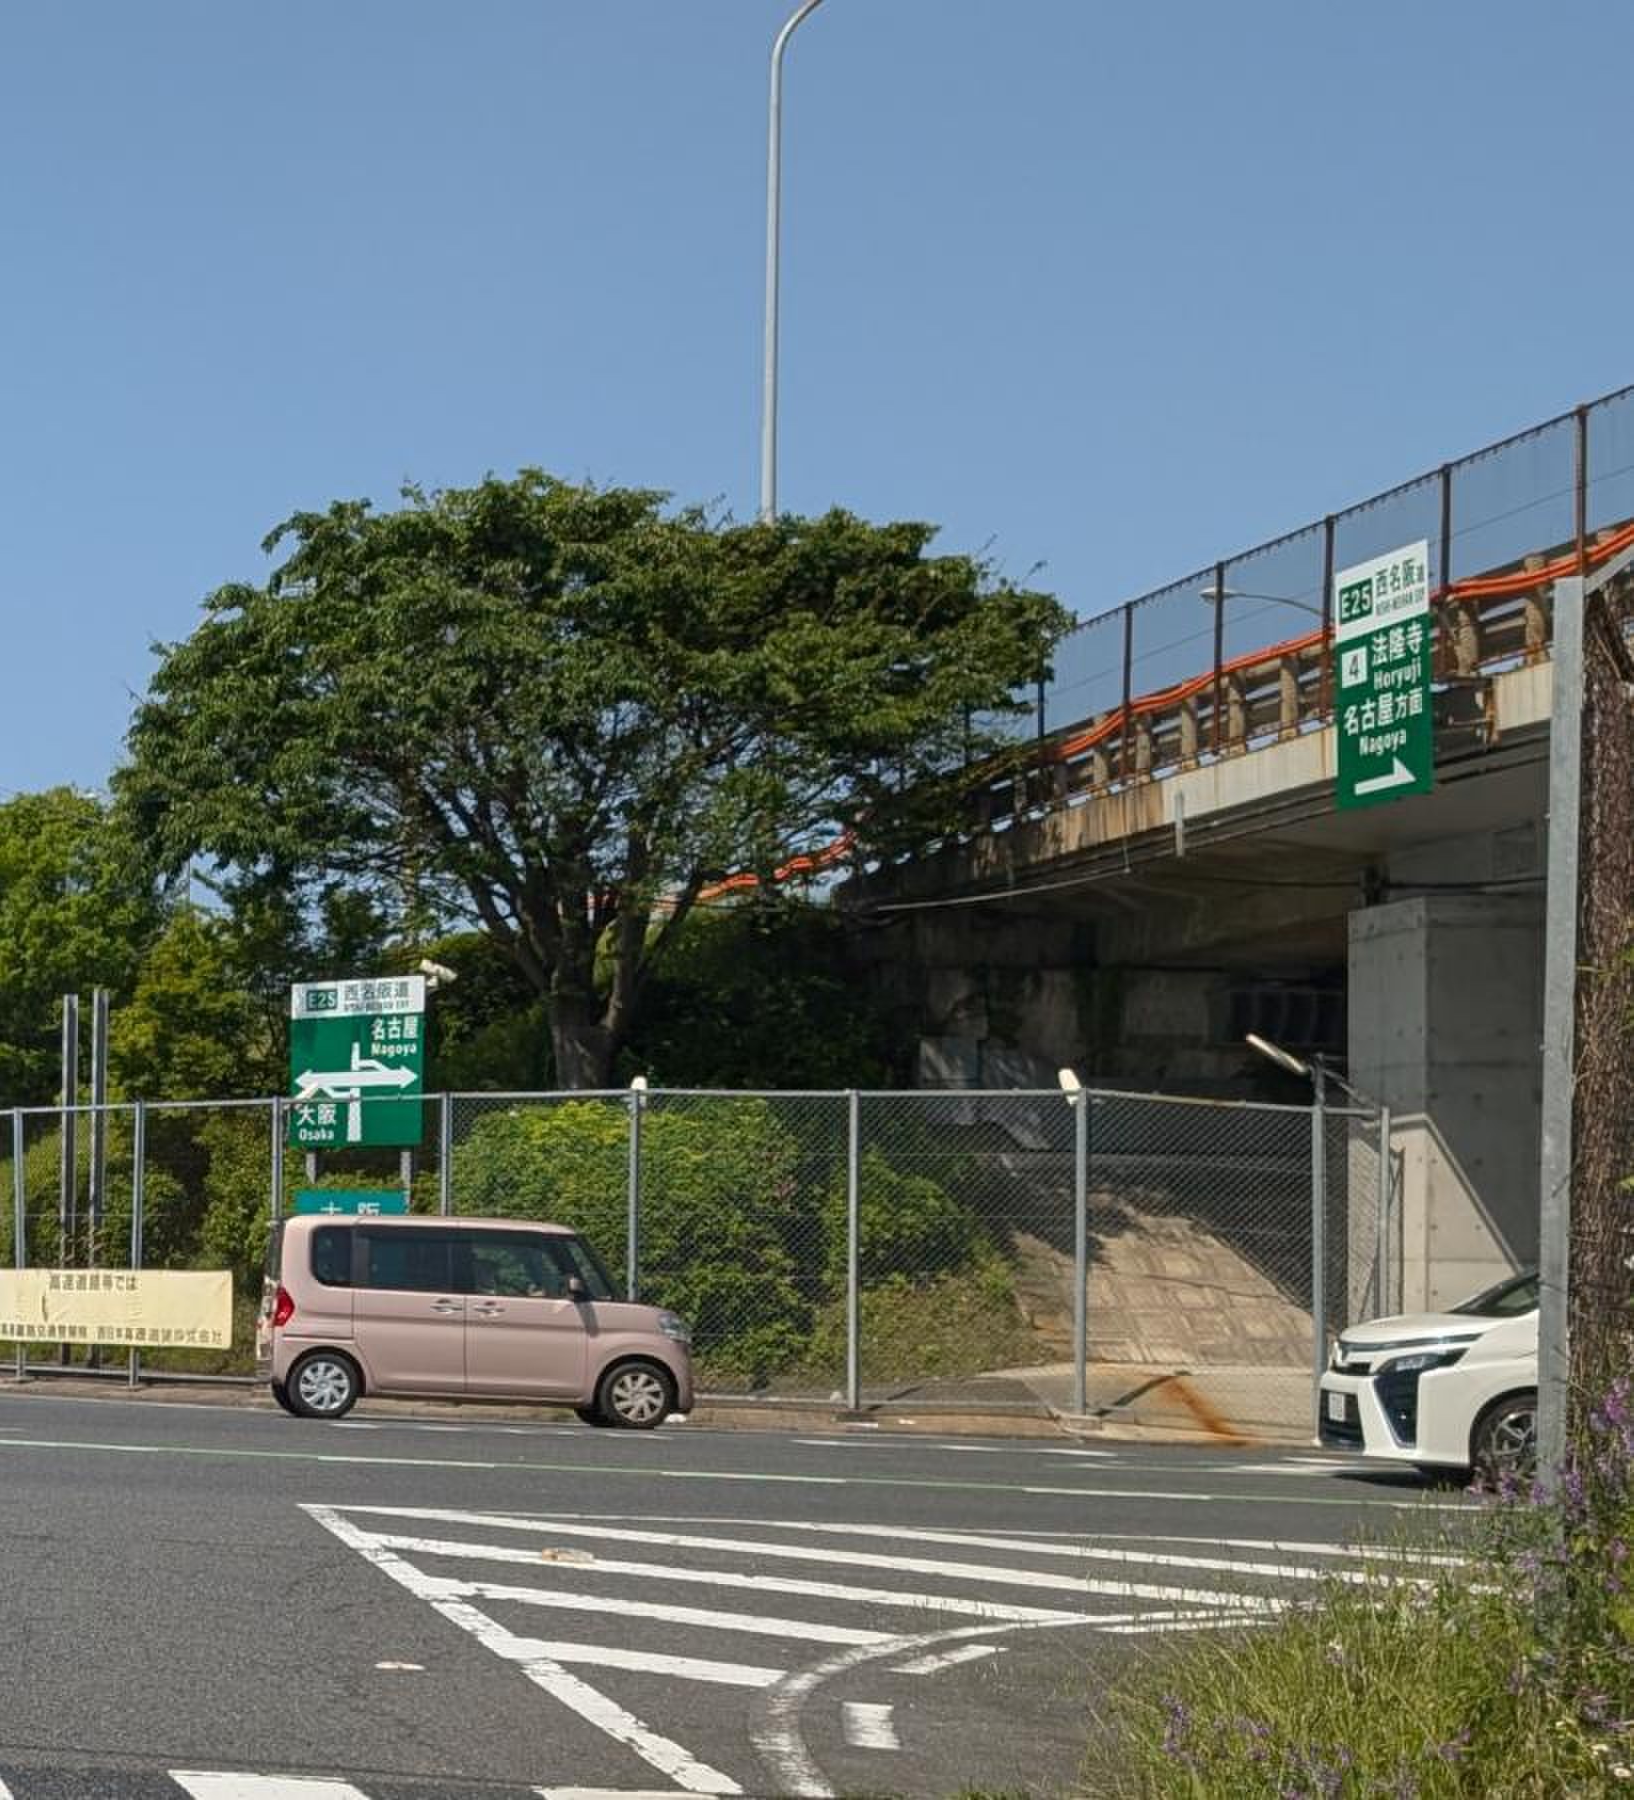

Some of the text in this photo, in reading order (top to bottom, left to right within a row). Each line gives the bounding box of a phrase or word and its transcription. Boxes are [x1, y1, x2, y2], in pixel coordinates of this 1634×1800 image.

[1341, 584, 1371, 618] E25
[1372, 621, 1423, 667] 法隆寺
[1349, 653, 1360, 680] 4
[1373, 655, 1422, 690] Horyuji
[1343, 687, 1423, 736] 名古屋方面
[1359, 728, 1407, 756] Nagoya
[371, 1015, 419, 1040] 名古屋
[370, 1041, 418, 1058] Nagoya
[297, 1103, 337, 1126] 大阪
[298, 1128, 335, 1141] Osaka
